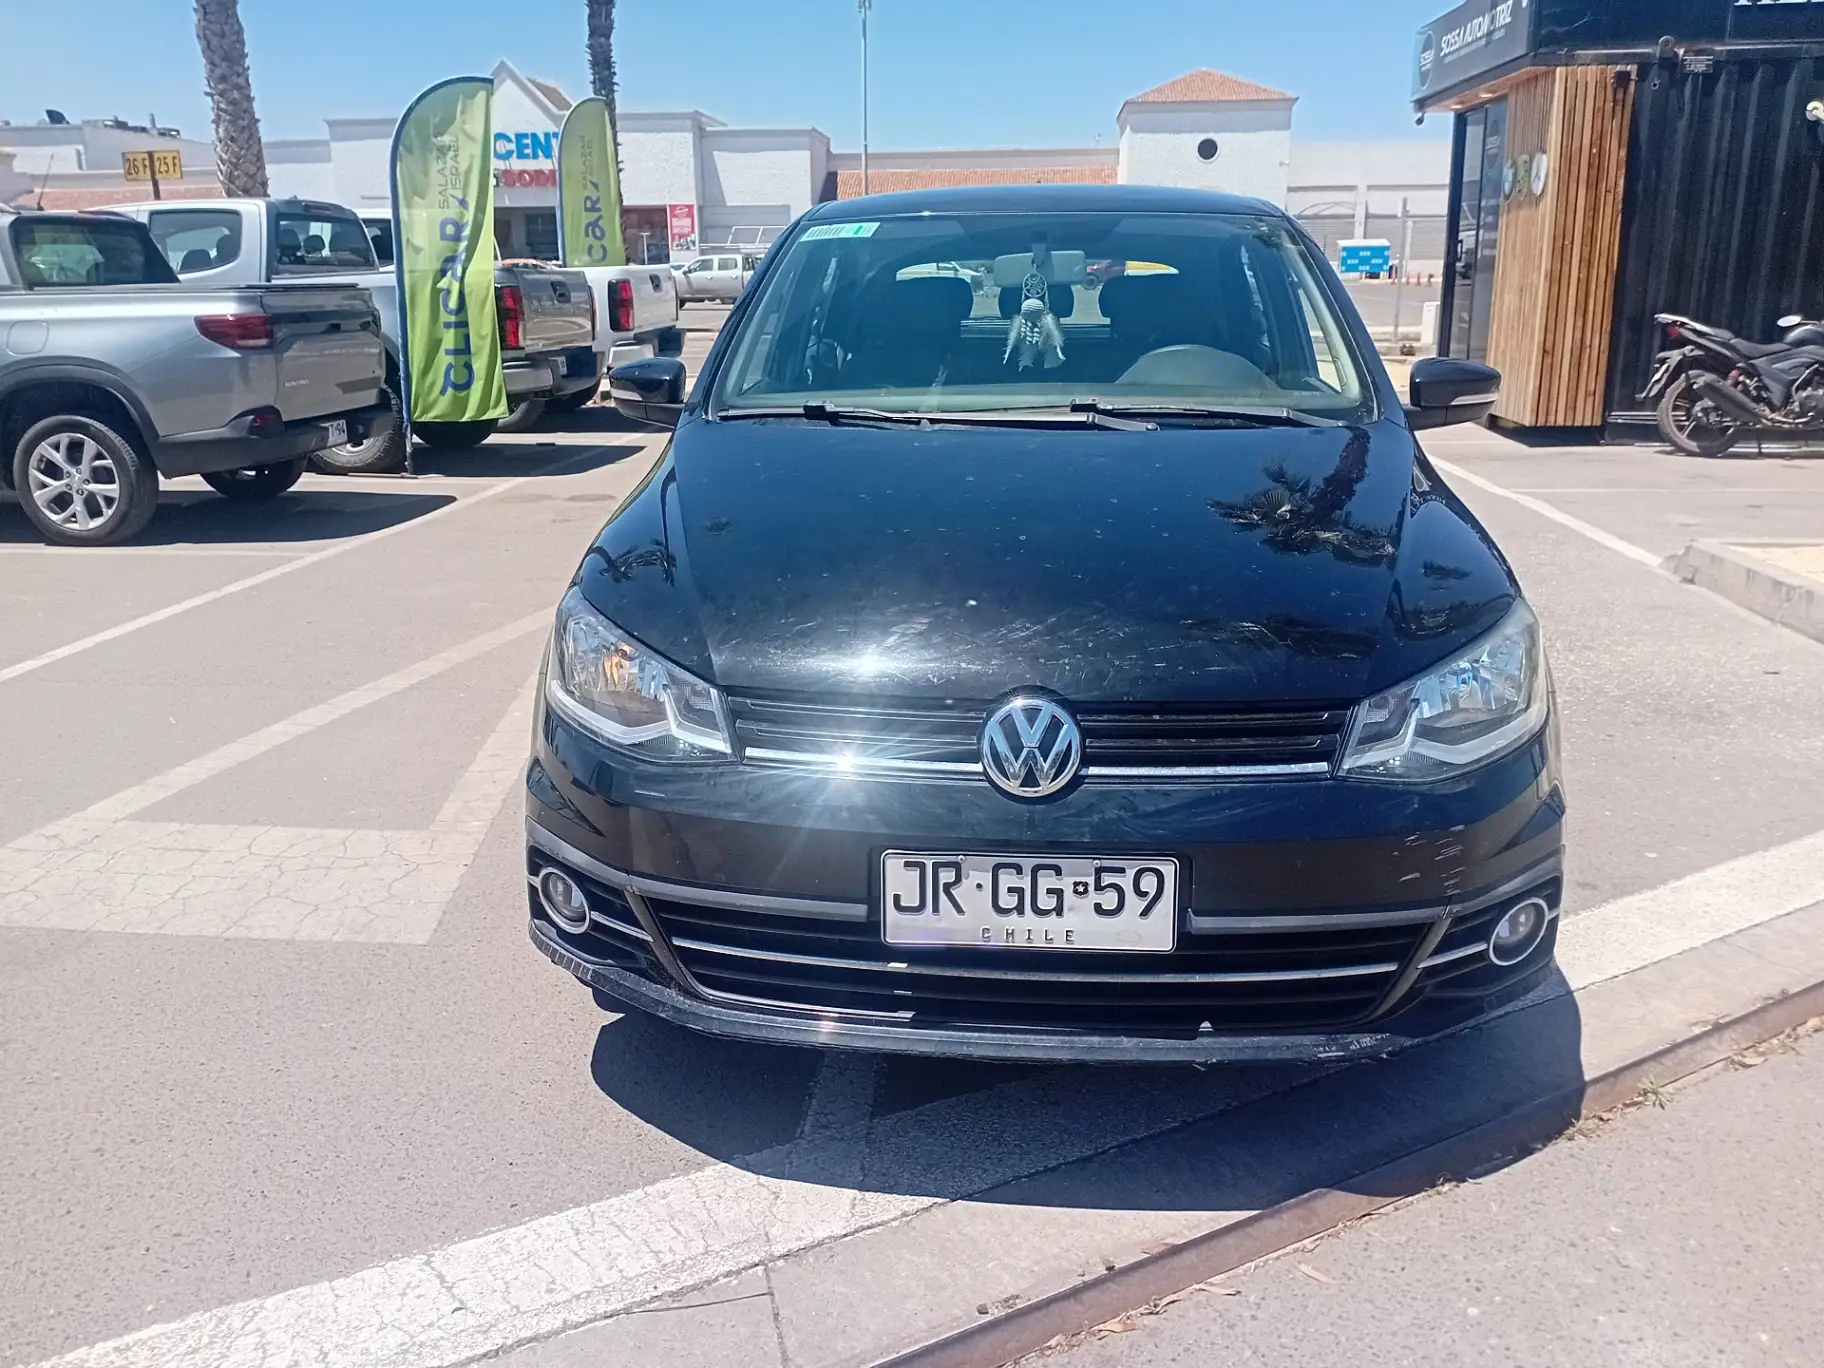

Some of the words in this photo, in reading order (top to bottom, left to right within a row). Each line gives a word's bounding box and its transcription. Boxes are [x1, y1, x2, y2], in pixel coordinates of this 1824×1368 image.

[126, 157, 139, 176] 26
[142, 157, 148, 175] F
[156, 156, 170, 174] 25
[172, 155, 178, 174] F
[448, 135, 462, 190] ISRAEL
[981, 927, 1075, 944] CHILE
